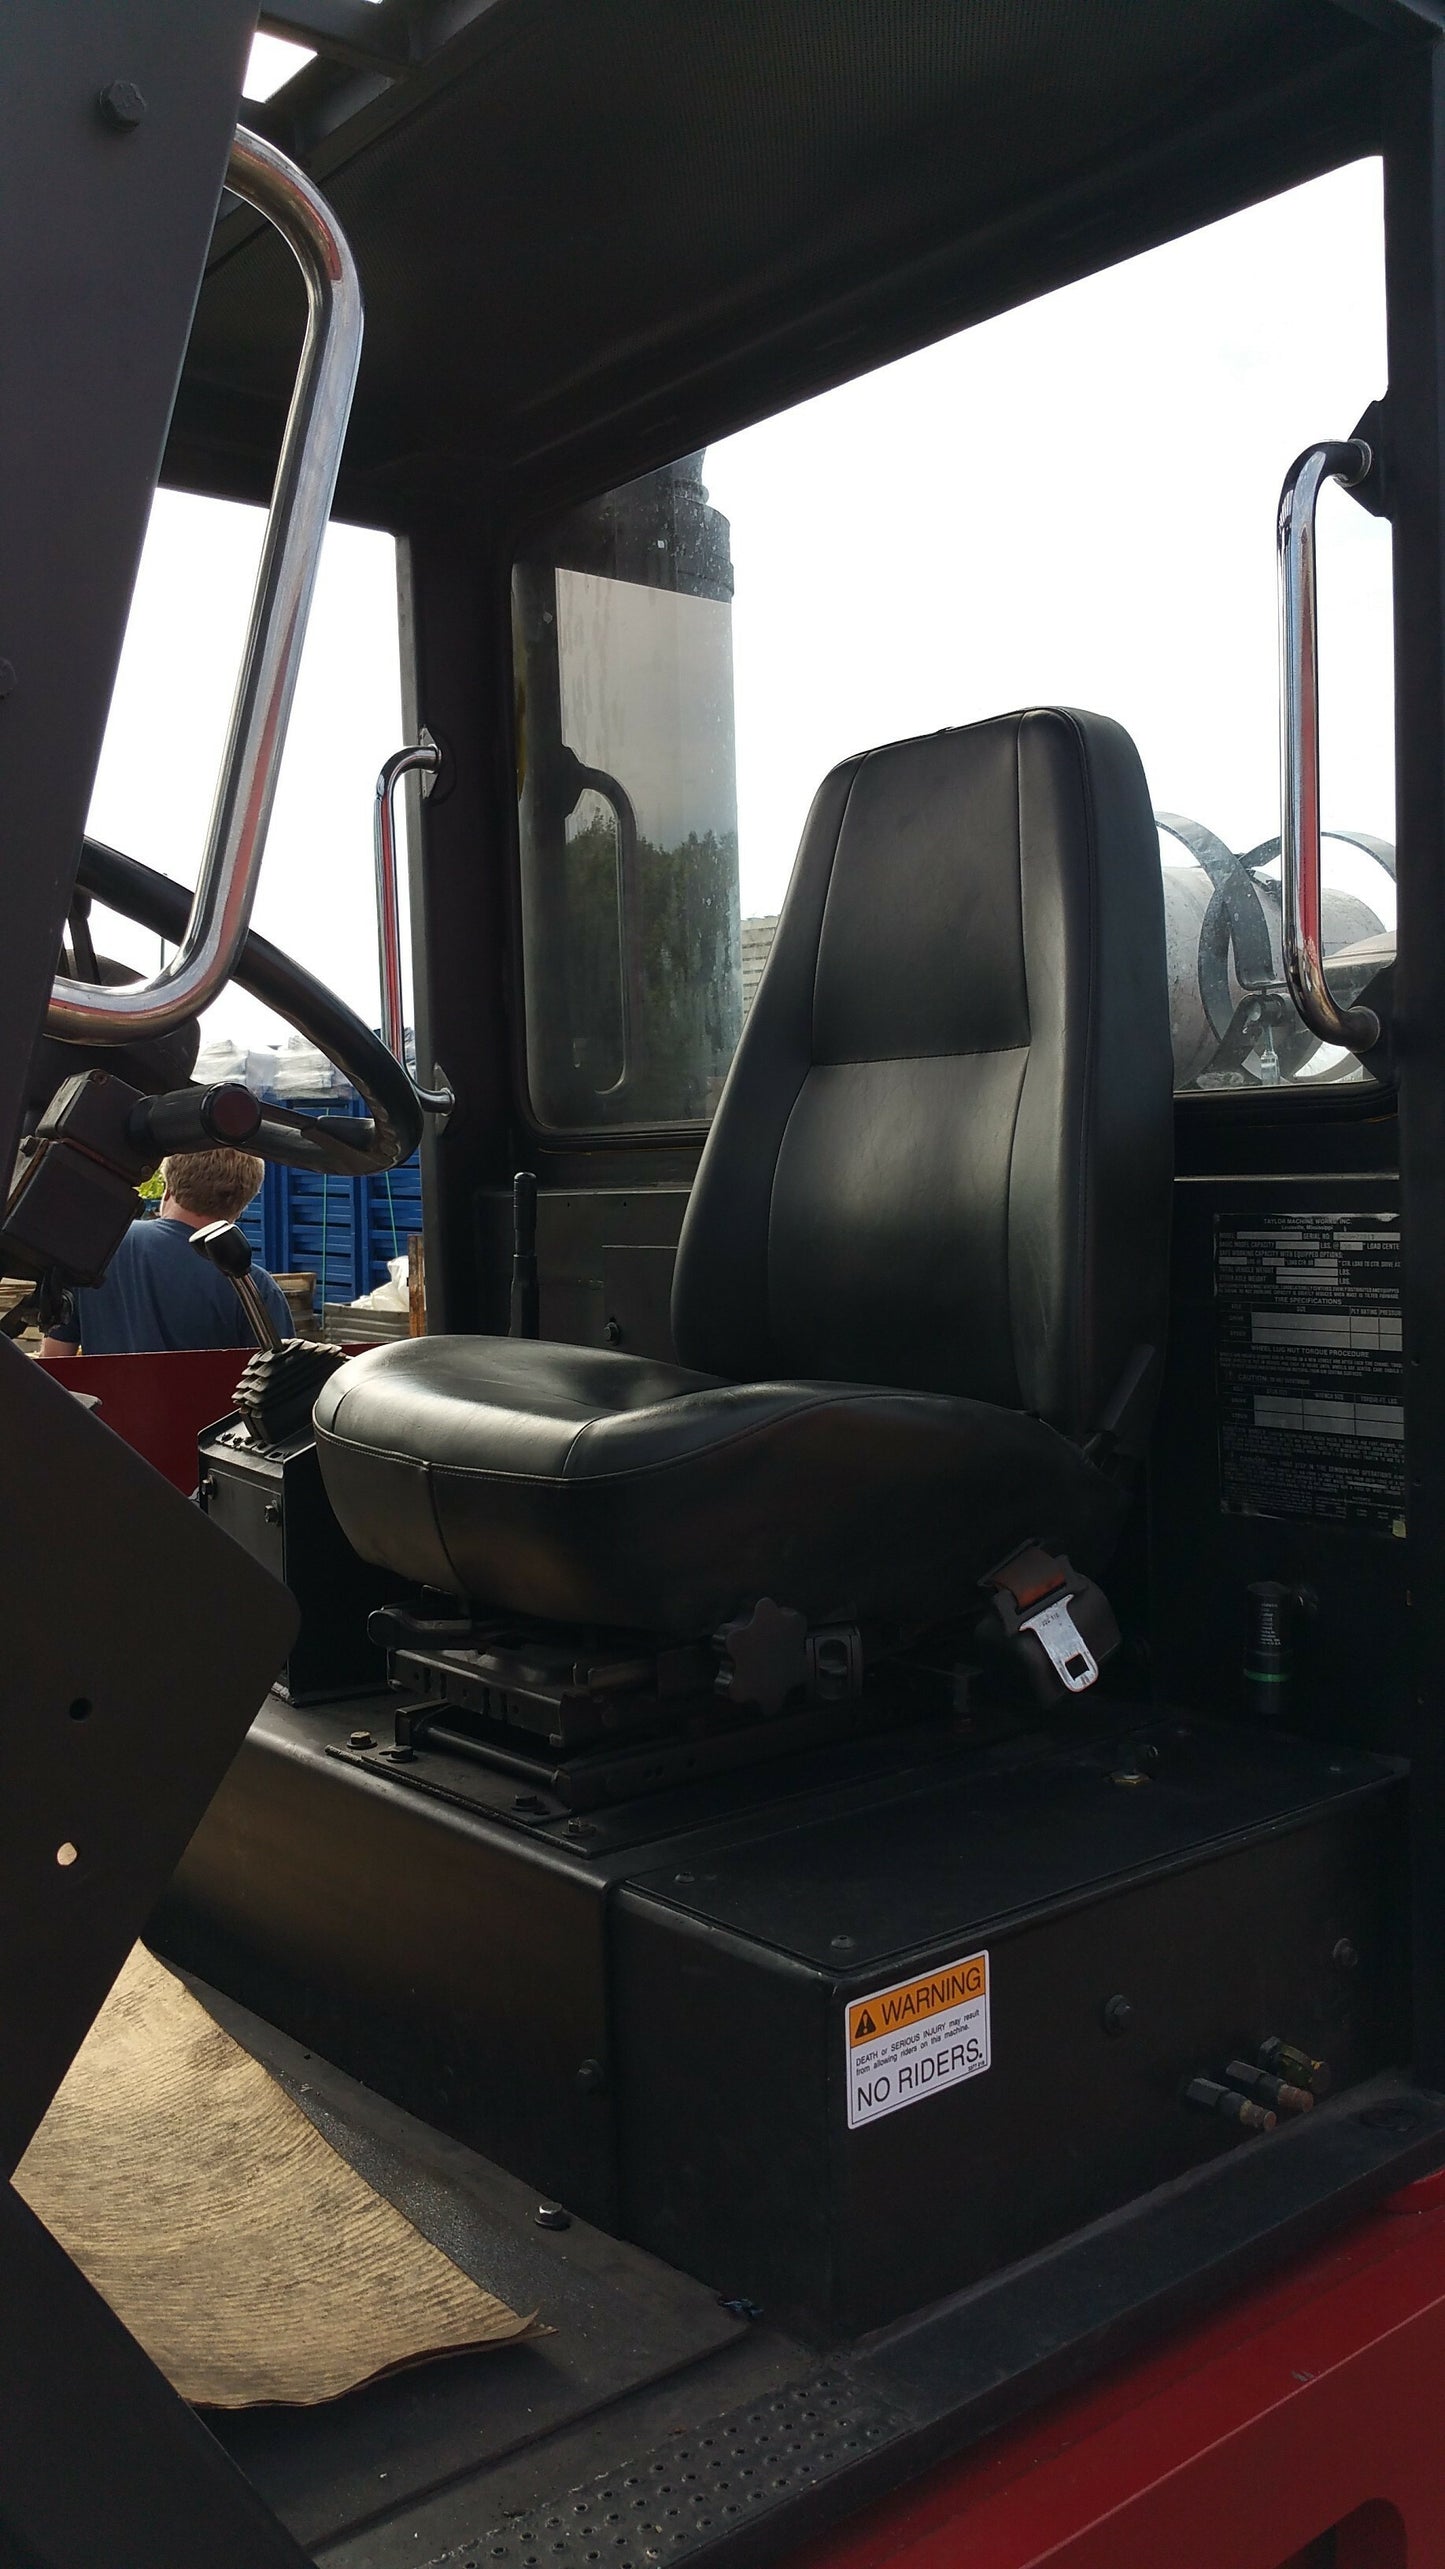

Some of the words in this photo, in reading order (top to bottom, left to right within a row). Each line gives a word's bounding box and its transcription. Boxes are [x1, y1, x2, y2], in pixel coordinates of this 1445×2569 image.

[881, 1966, 981, 2026] WARNING
[856, 2051, 878, 2067] DEATH
[880, 2048, 888, 2056] or
[891, 2033, 920, 2052] SERIOUS
[923, 2022, 946, 2039] INJURY
[949, 2017, 961, 2027] may
[964, 2009, 980, 2021] result
[856, 2065, 870, 2076] from
[873, 2053, 898, 2069] allowing
[901, 2045, 917, 2057] riders
[920, 2041, 928, 2049] on
[931, 2034, 941, 2045] this
[944, 2024, 969, 2040] machine.
[857, 2076, 891, 2111] NO
[899, 2038, 983, 2094] RIDERS.
